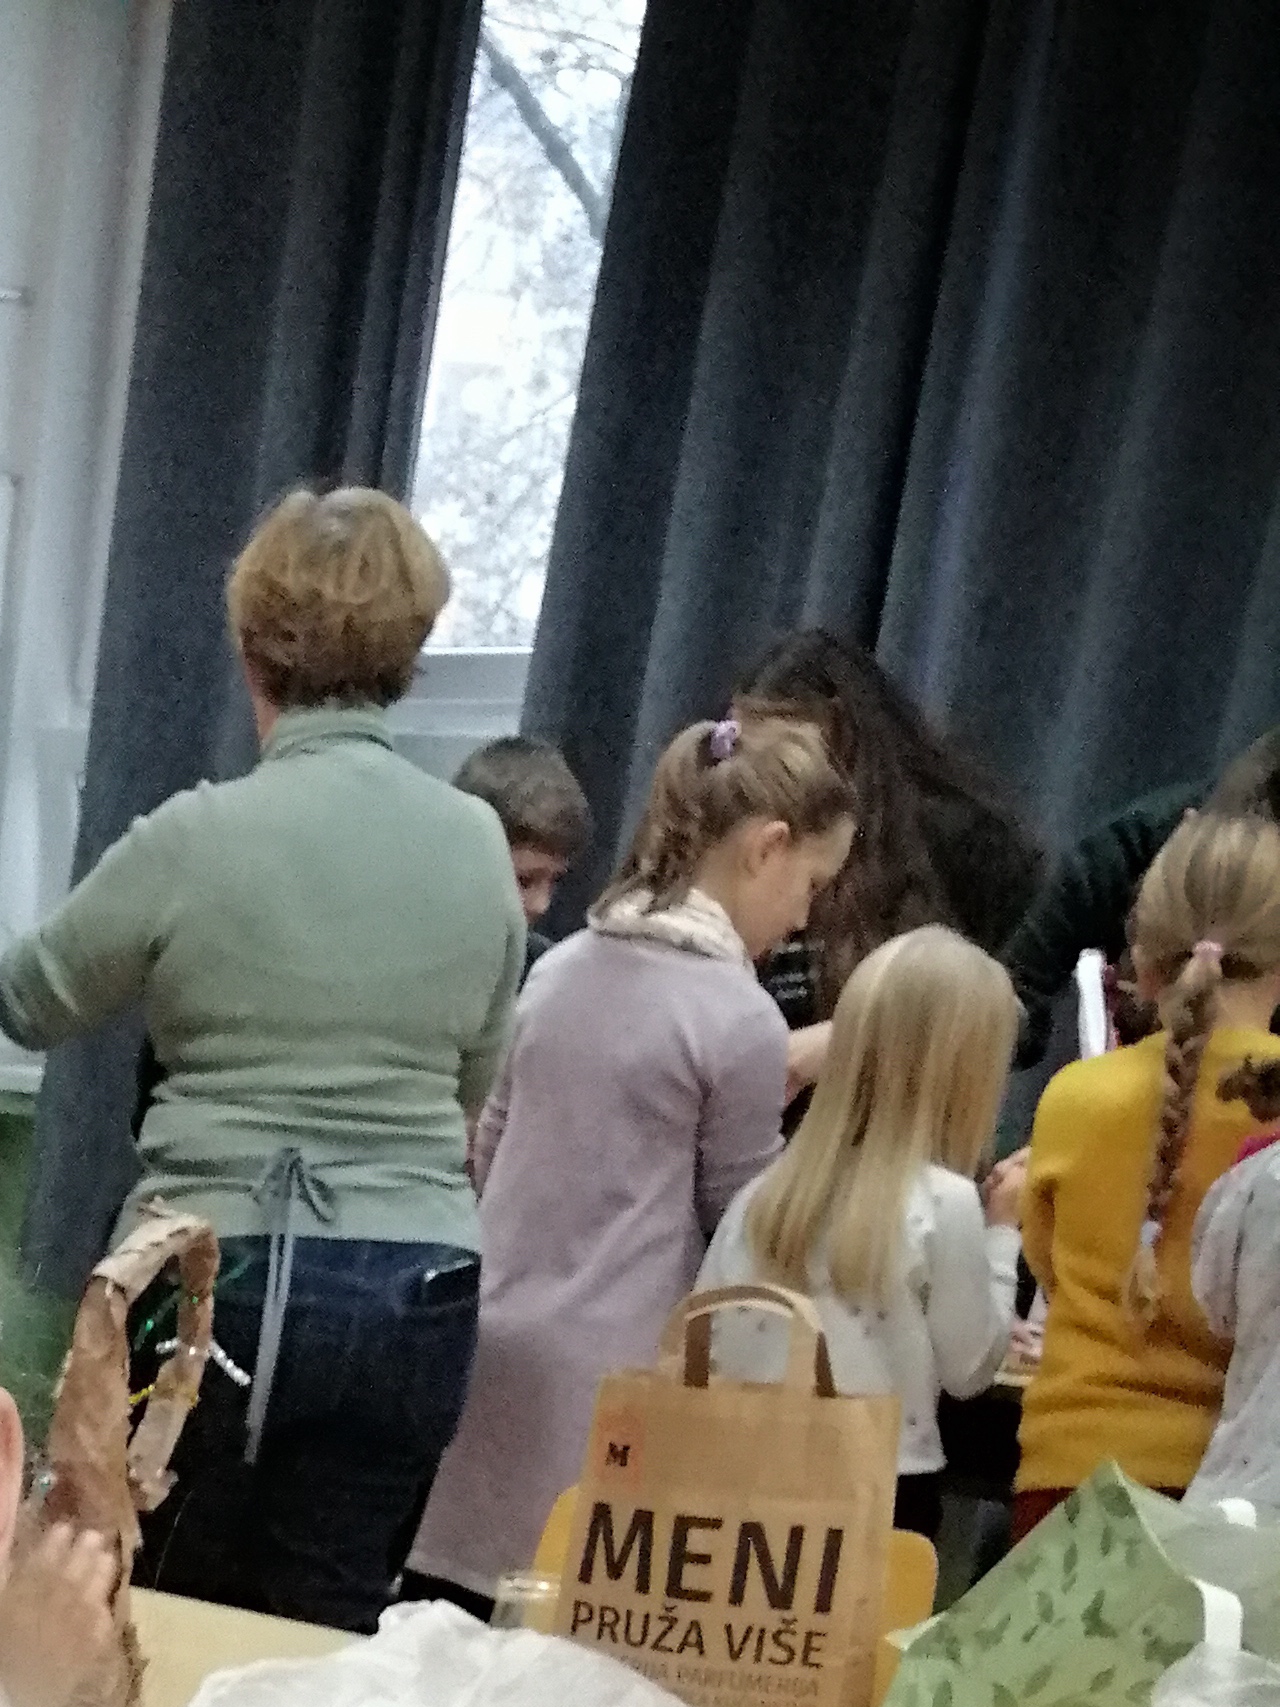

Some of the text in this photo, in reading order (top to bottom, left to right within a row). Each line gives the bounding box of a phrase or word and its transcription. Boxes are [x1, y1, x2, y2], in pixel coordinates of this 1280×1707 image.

[577, 1500, 846, 1615] MENI
[570, 1599, 706, 1656] PRUŽA
[723, 1617, 828, 1669] VIŠE
